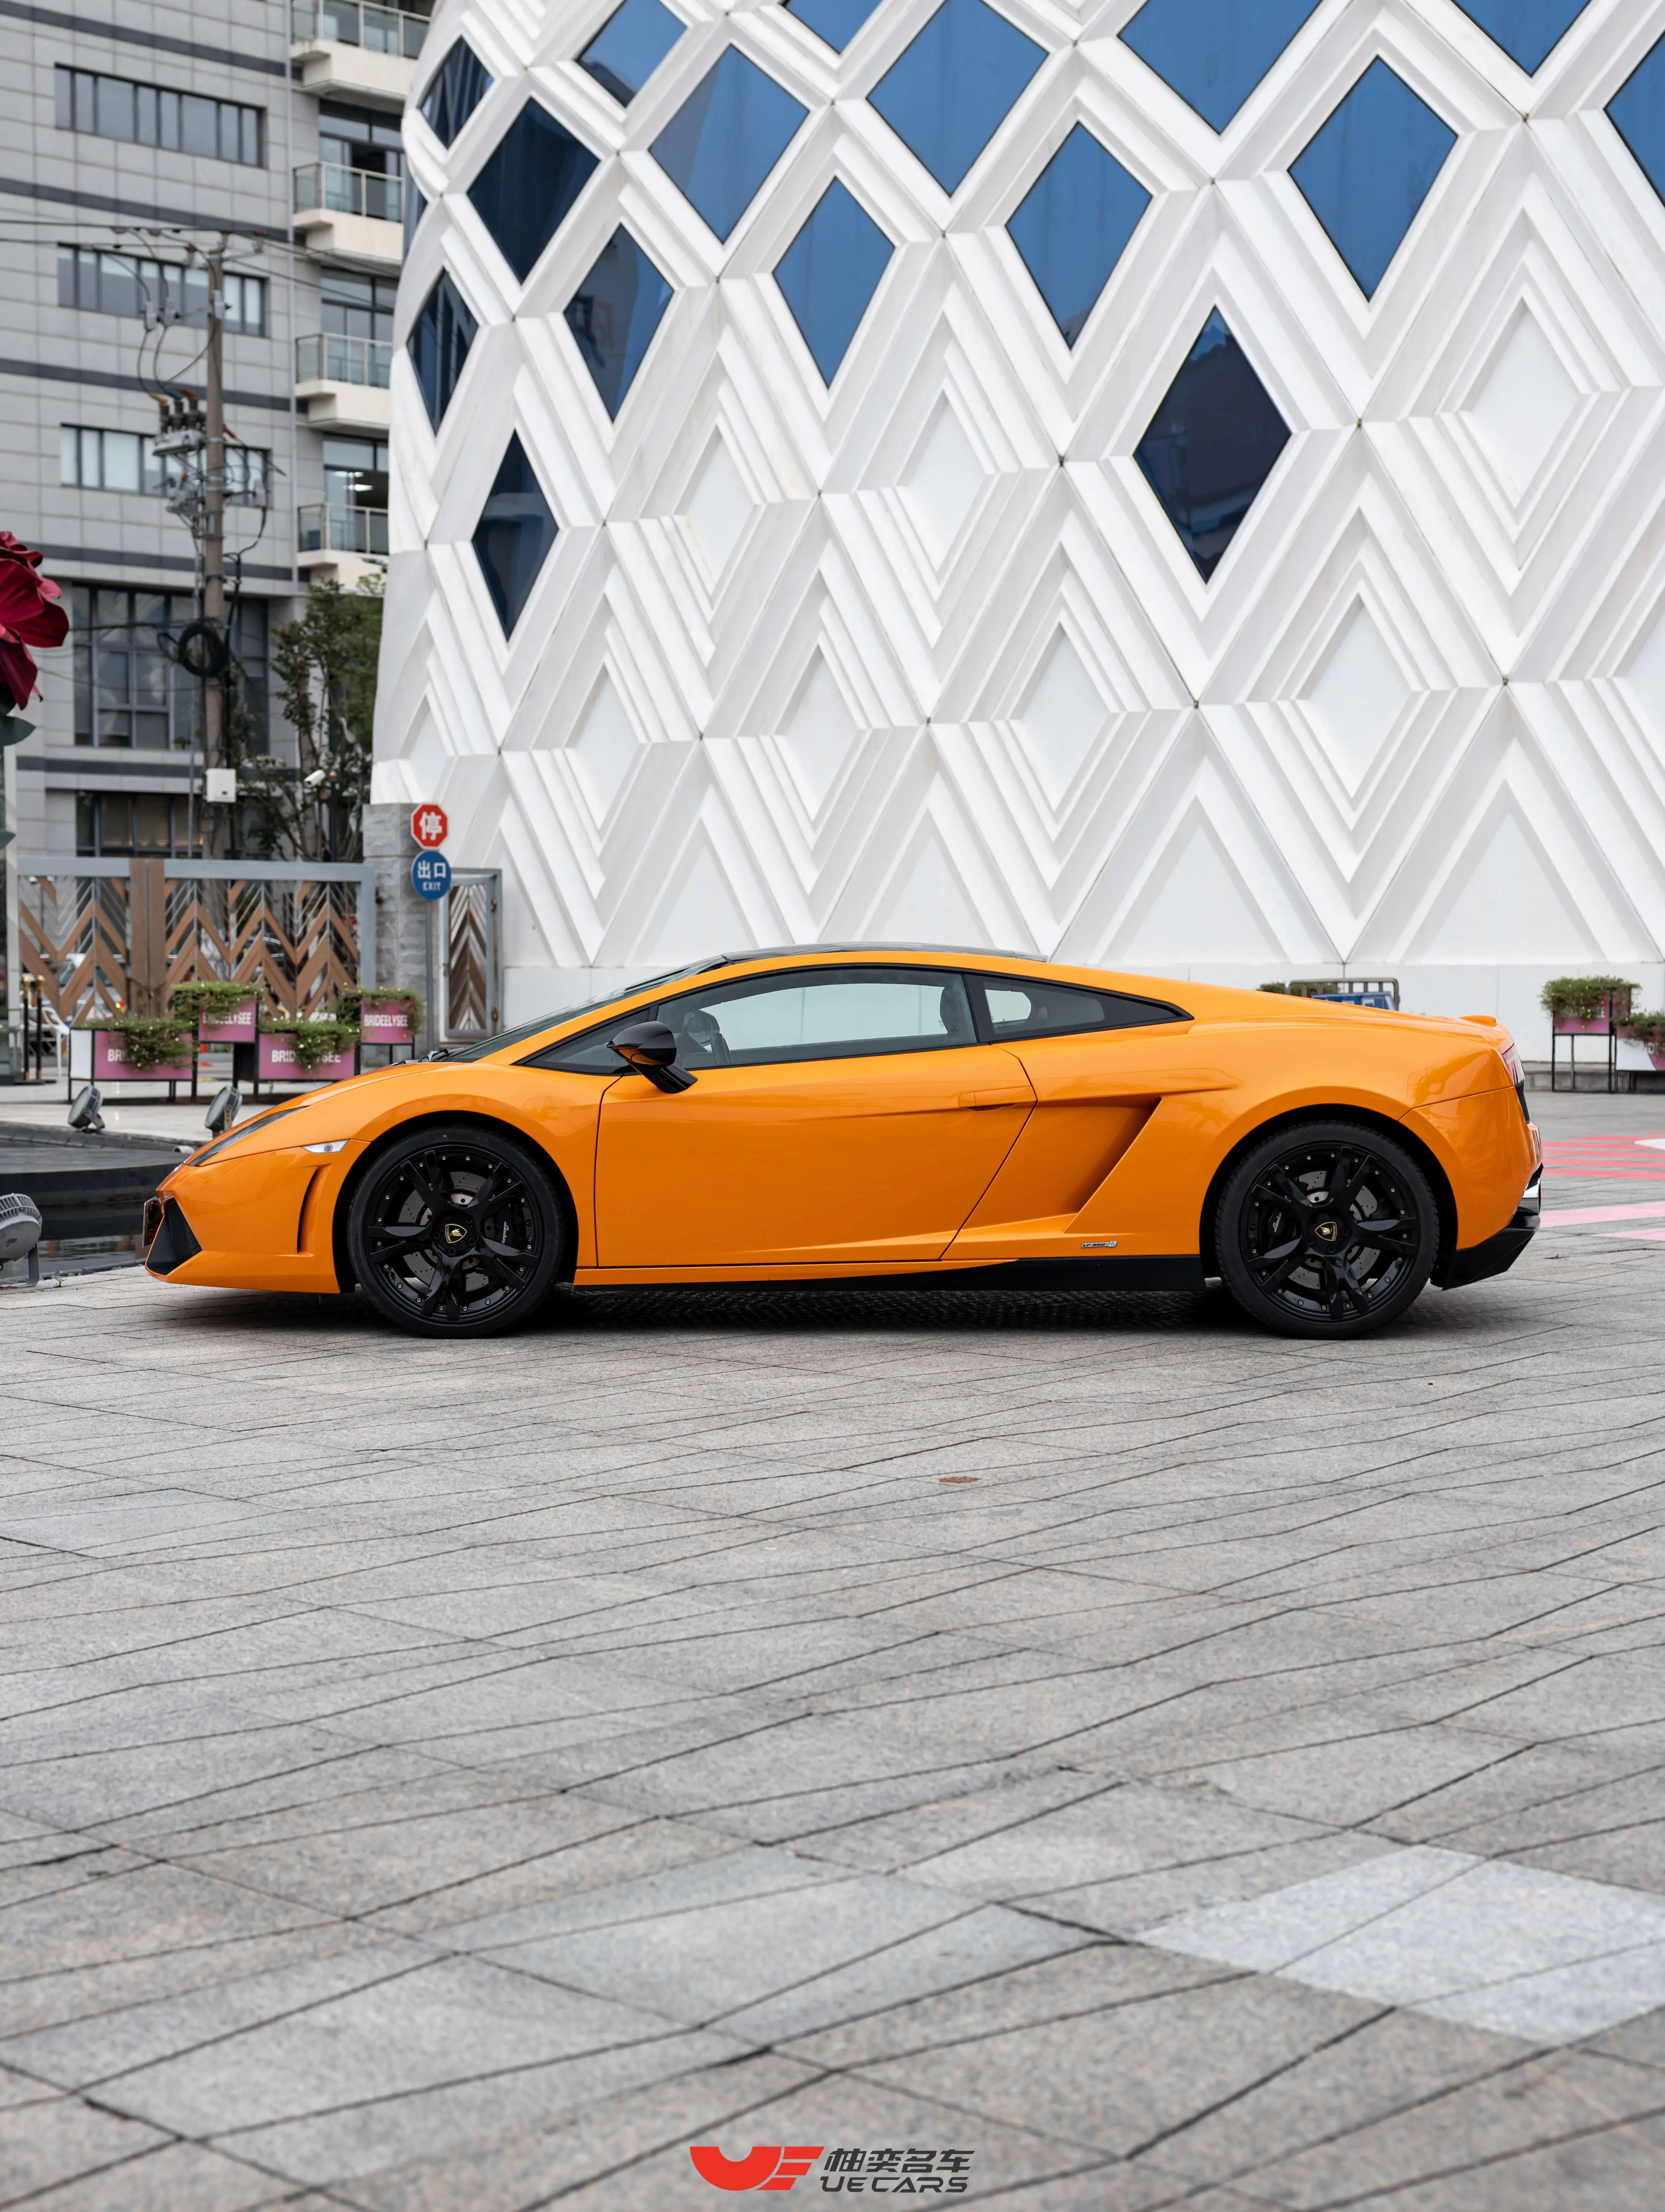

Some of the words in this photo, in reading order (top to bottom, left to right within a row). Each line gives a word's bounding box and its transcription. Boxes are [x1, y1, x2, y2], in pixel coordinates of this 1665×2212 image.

[419, 811, 442, 840] 停
[418, 860, 446, 879] 出口
[423, 881, 441, 891] EXIT
